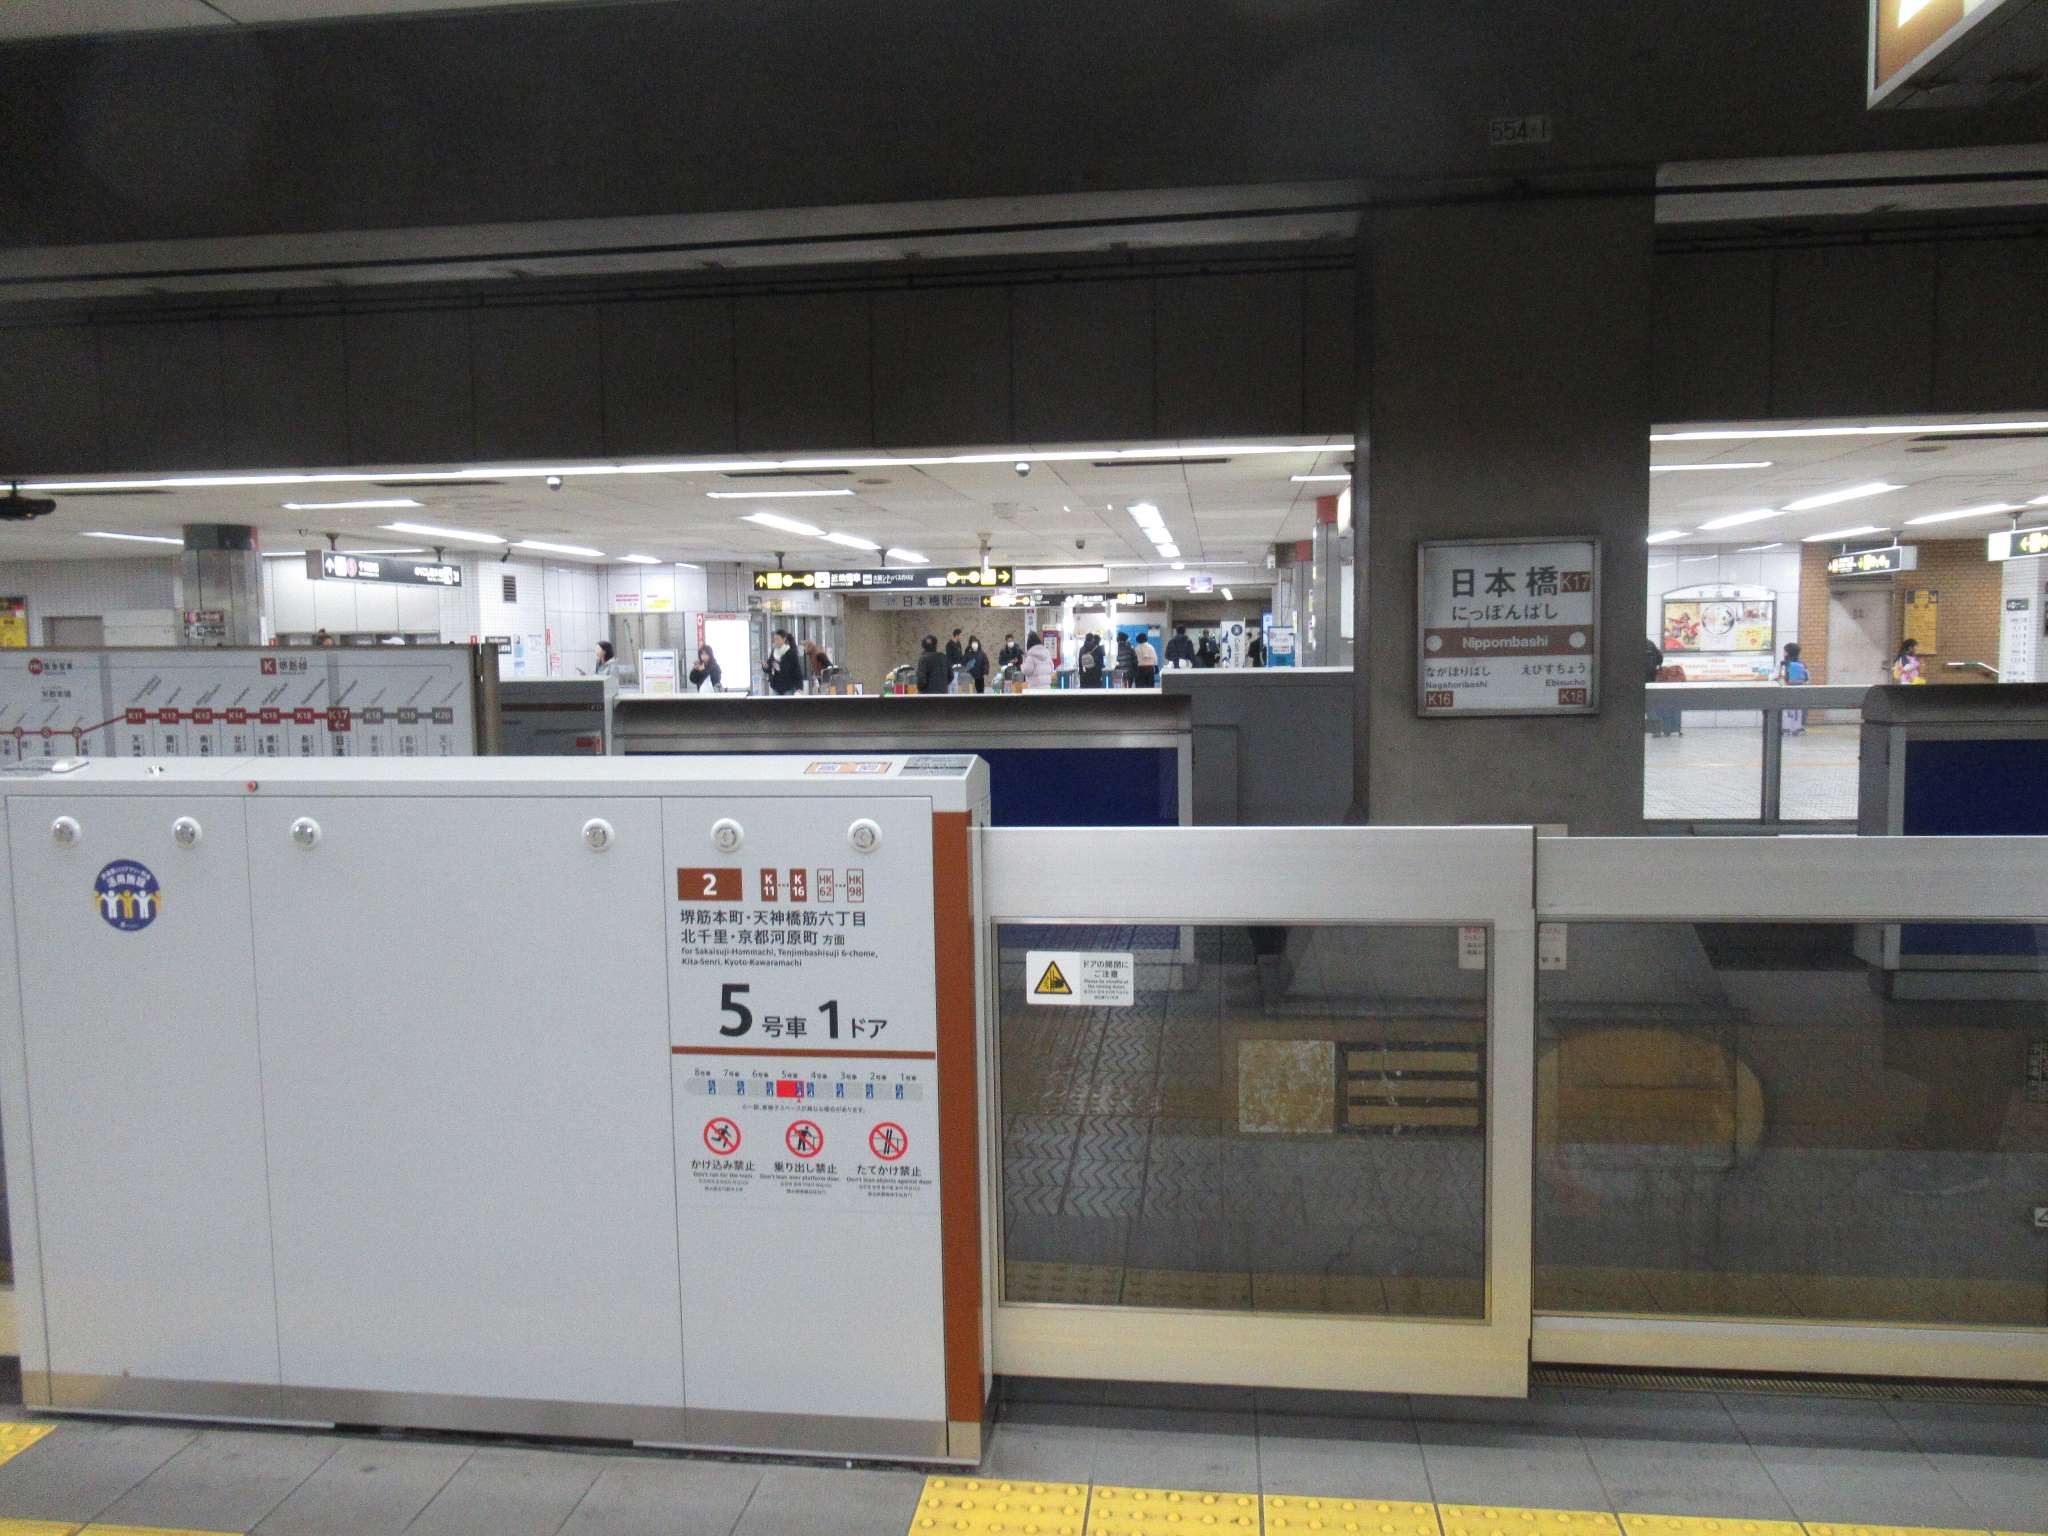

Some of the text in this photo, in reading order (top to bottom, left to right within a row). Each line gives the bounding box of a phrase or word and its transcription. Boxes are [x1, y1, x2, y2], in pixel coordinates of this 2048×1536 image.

[1452, 566, 1591, 598] 日本橋 K17
[1452, 603, 1558, 622] にっぽんばし
[1462, 634, 1549, 651] Nippombashi
[1426, 662, 1586, 678] ながほりばし えびすちょう
[1425, 678, 1586, 690] Nagahoribashi Ebisucho
[1427, 690, 1585, 706] K16 K18
[228, 712, 243, 721] K14
[328, 710, 348, 720] K17
[702, 873, 717, 896] 2
[765, 875, 862, 885] K K HK HK
[763, 886, 862, 897] 11 16 62 98
[680, 909, 867, 927] 堺筋本町・天神橋筋六丁目
[680, 928, 846, 946] 北千里・京都河原町 方面
[681, 947, 693, 956] for
[778, 948, 840, 959] Tenjimbashisuji
[681, 957, 802, 968] Kita-Senri, Kyoto-Kawaramachi
[691, 1159, 755, 1172] かけ込み禁止
[774, 1161, 838, 1174] 乗り出し禁止
[857, 1164, 922, 1177] たてかけ禁止
